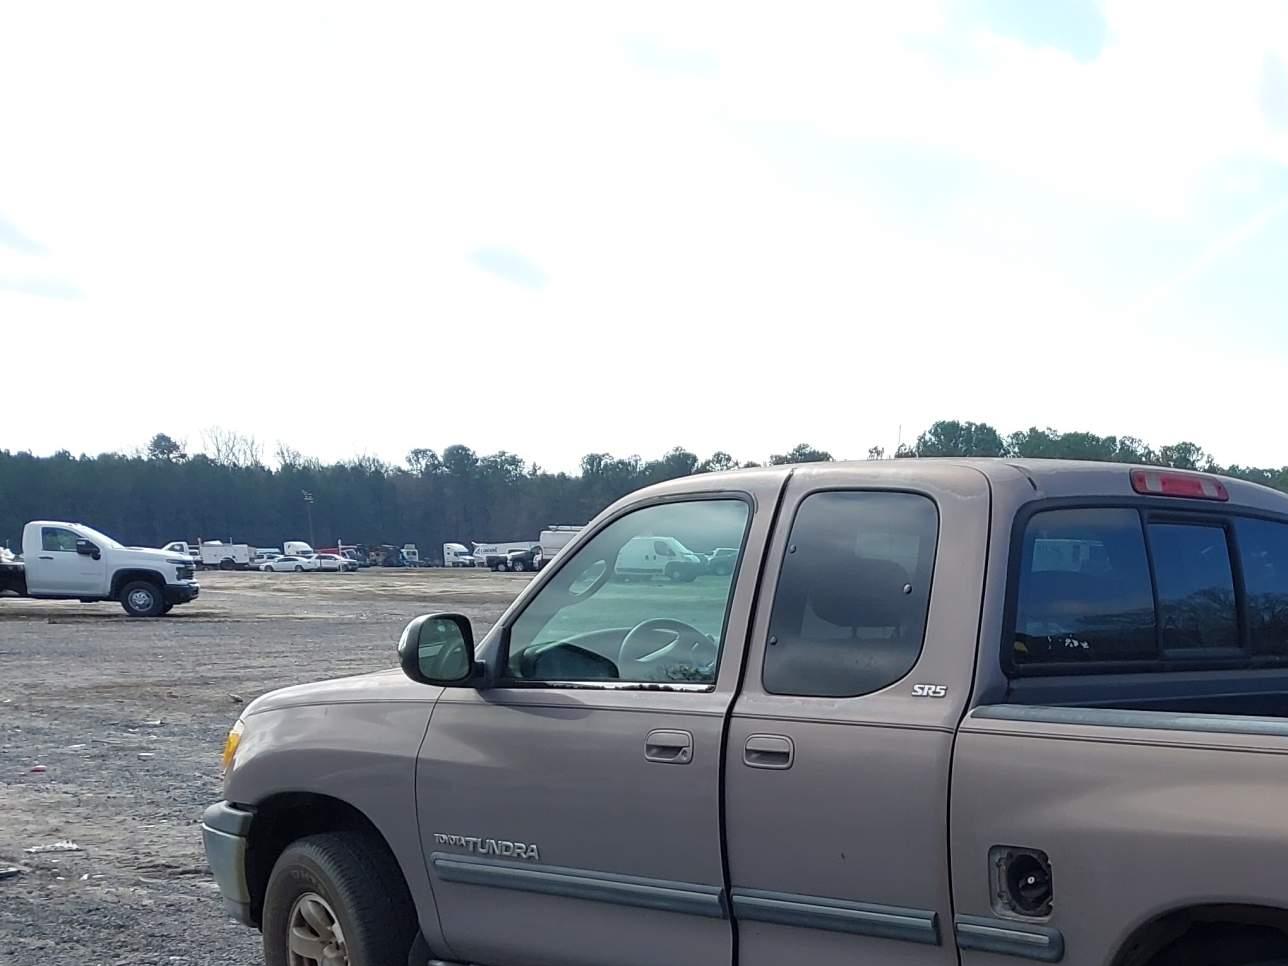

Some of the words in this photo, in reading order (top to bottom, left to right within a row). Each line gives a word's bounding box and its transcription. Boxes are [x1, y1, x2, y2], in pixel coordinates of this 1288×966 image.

[911, 684, 947, 698] SR5
[433, 833, 466, 847] TOYOTA
[465, 837, 540, 860] TUNDRA
